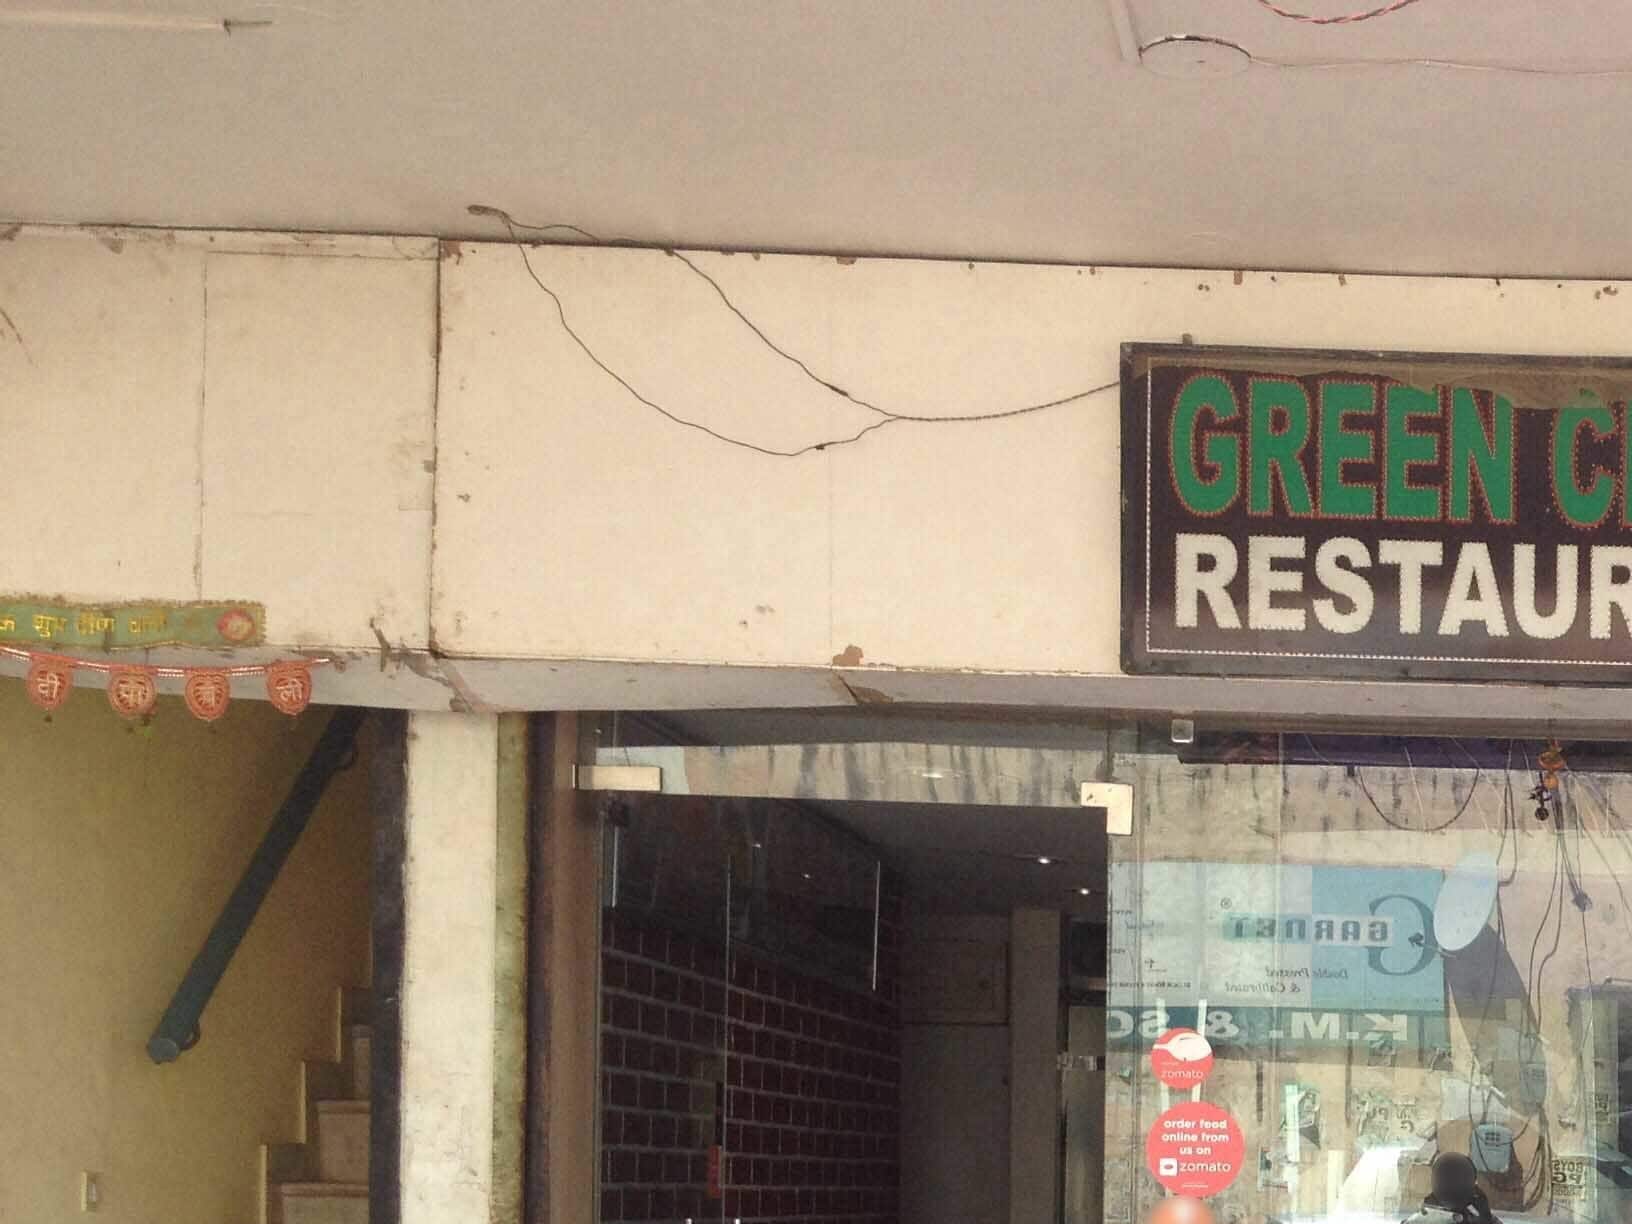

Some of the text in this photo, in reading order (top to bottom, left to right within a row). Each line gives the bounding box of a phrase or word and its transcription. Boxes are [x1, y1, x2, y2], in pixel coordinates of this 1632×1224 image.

[1168, 372, 1517, 522] GREEN
[1161, 1067, 1204, 1079] zomato
[1163, 1118, 1228, 1129] order food
[1161, 1131, 1230, 1142] online from
[1179, 1146, 1212, 1155] us on
[1179, 1160, 1232, 1173] zomato
